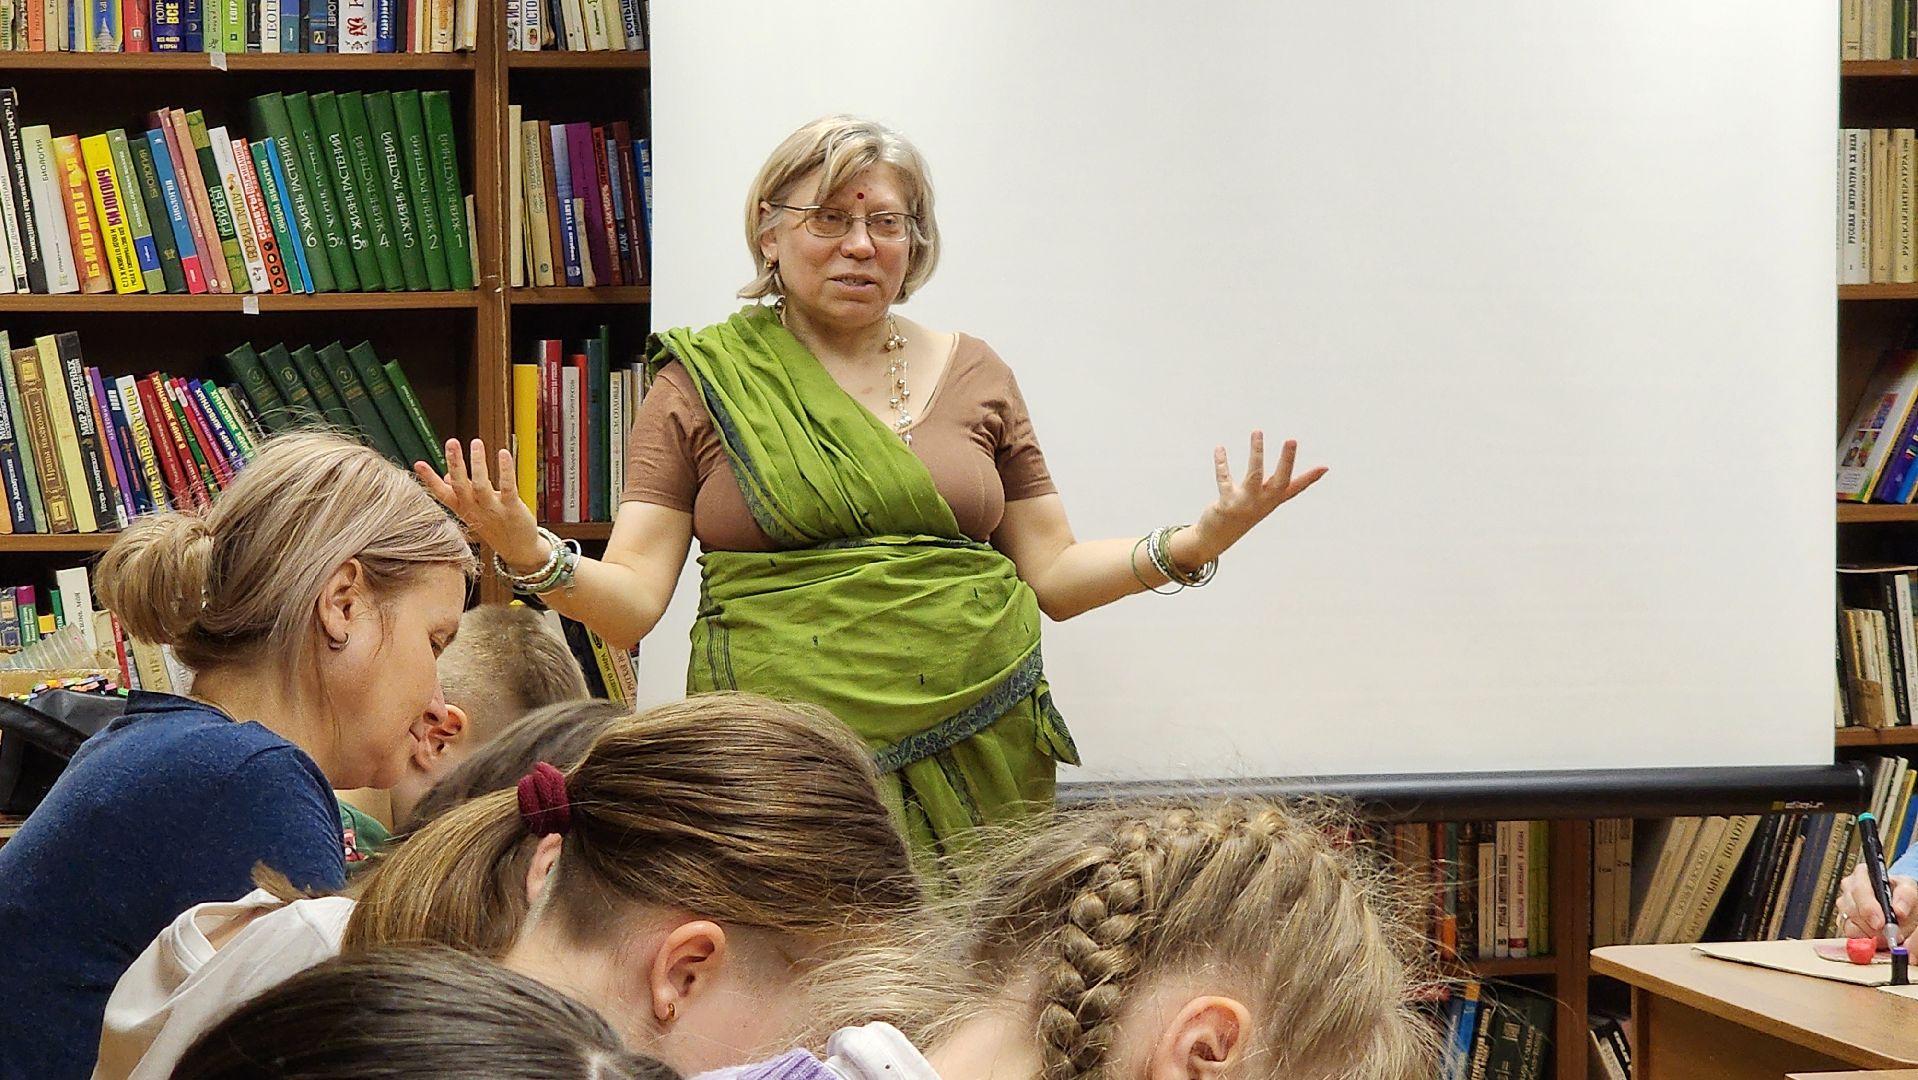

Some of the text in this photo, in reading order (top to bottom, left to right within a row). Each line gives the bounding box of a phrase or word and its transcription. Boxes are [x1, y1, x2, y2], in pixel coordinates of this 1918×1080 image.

[165, 2, 180, 24] ВСЕ
[35, 138, 49, 182] БИОЛОГИЯ
[138, 148, 159, 199] БИОЛОГИЯ
[328, 132, 363, 231] ЖИЗНЬ РАСТЕНИЙ
[380, 131, 412, 232] ЖИЗНЬ РАСТЕНИЙ
[95, 168, 123, 227] БИОЛОГИЯ
[165, 179, 182, 222] БИОЛОГИЯ
[260, 159, 287, 234] ОБЩАЯ БИОЛОГИЯ
[277, 136, 314, 231] ЖИЗНЬ РАСТЕНИЙ
[1847, 166, 1857, 210] ЛИТЕРАТУРА
[65, 157, 101, 278] БИОЛОГИЯ
[214, 189, 233, 234] ГРИБЫ
[231, 192, 258, 259] АТЛАС ГРИБОВ
[247, 194, 268, 240] СОВЕТЫ
[1847, 212, 1856, 244] РУССКАЯ
[305, 232, 318, 248] 6
[379, 233, 390, 248] 4
[403, 232, 415, 248] 3
[429, 234, 439, 250] 2
[455, 233, 463, 248] 1
[619, 232, 629, 252] КАК
[66, 359, 91, 436] МИР ЖИВОТНЫХ
[151, 375, 175, 420] ЖИВОТНЫХ
[195, 387, 222, 430] ЖИВОТНЫХ
[210, 389, 239, 431] ЖИВОТНЫХ
[33, 400, 49, 449] насекомых
[169, 421, 183, 444] МИРЕ
[219, 431, 234, 451] МИРЕ
[235, 431, 251, 452] МИРЕ
[15, 500, 25, 522] Игорь
[97, 491, 107, 512] Игорь
